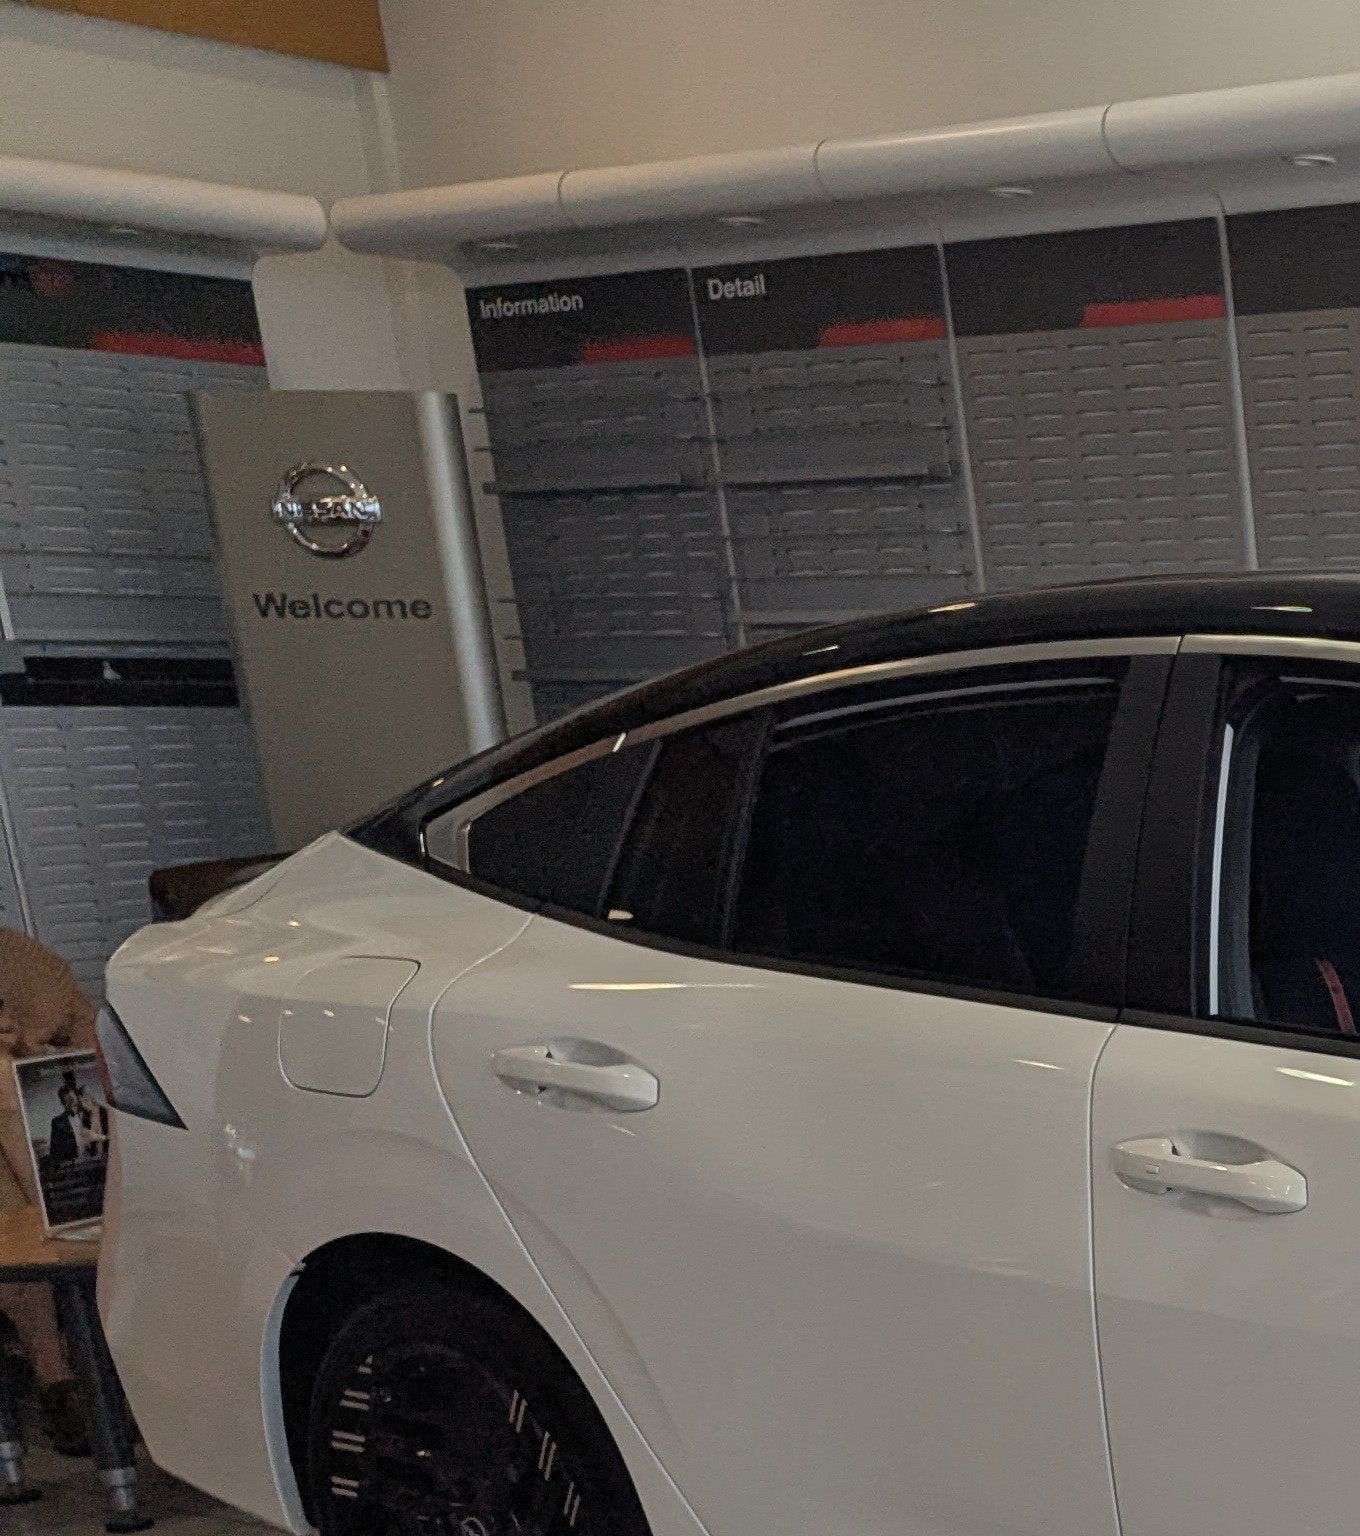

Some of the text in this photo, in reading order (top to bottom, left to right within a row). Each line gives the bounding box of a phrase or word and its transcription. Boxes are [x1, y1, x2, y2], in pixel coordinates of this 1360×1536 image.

[706, 273, 767, 301] Detail
[478, 291, 585, 320] Information
[252, 592, 433, 620] Welcome
